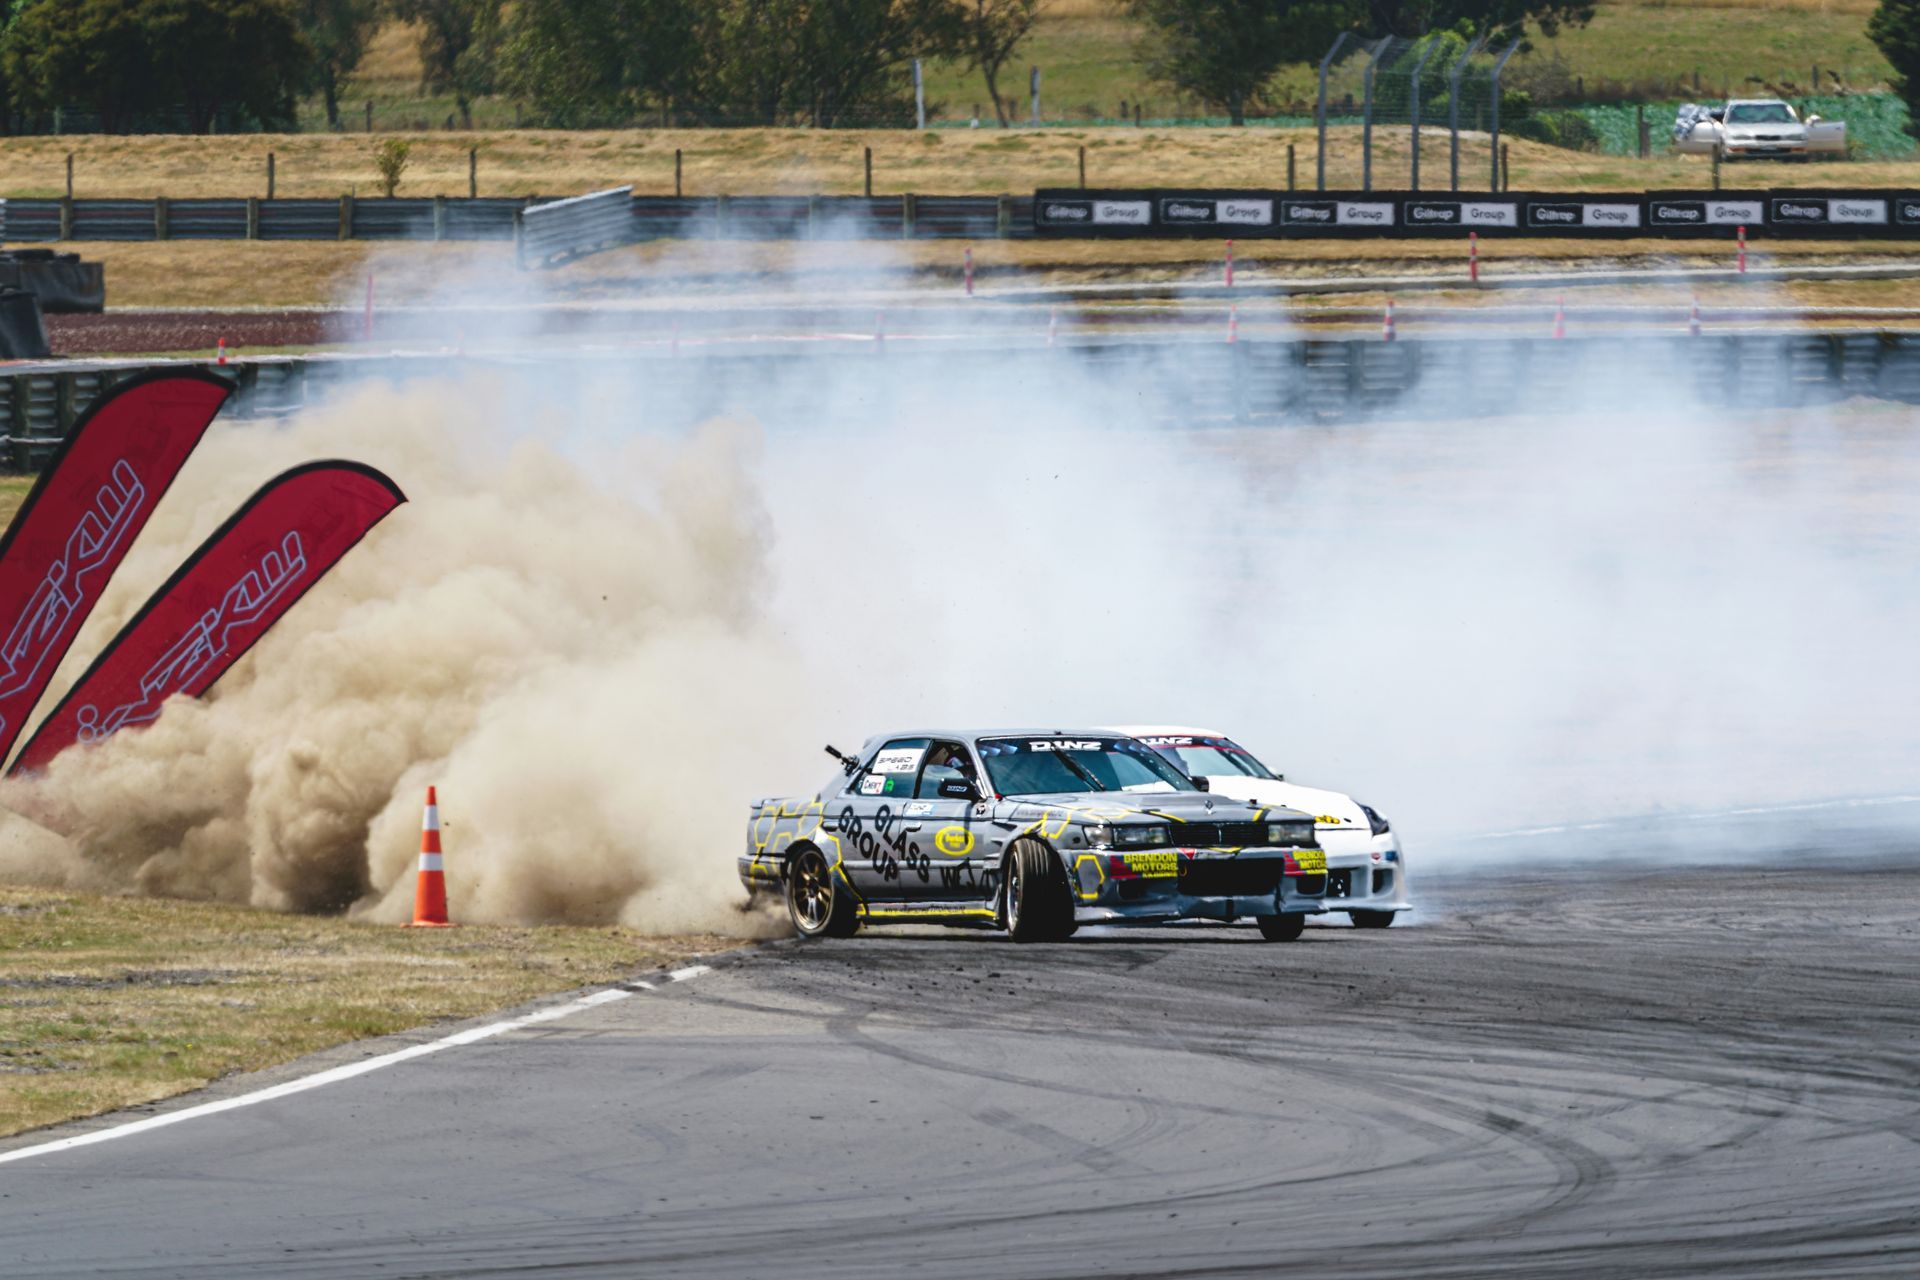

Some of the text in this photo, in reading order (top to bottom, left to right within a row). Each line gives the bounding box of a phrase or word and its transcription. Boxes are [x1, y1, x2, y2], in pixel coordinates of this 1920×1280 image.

[1226, 205, 1260, 219] Group
[1347, 207, 1382, 221] Group
[1471, 208, 1505, 222] Group
[1592, 208, 1628, 223] Group
[1714, 206, 1751, 219] Group
[1123, 853, 1178, 863] BRENDON
[1132, 862, 1178, 871] MOTORS
